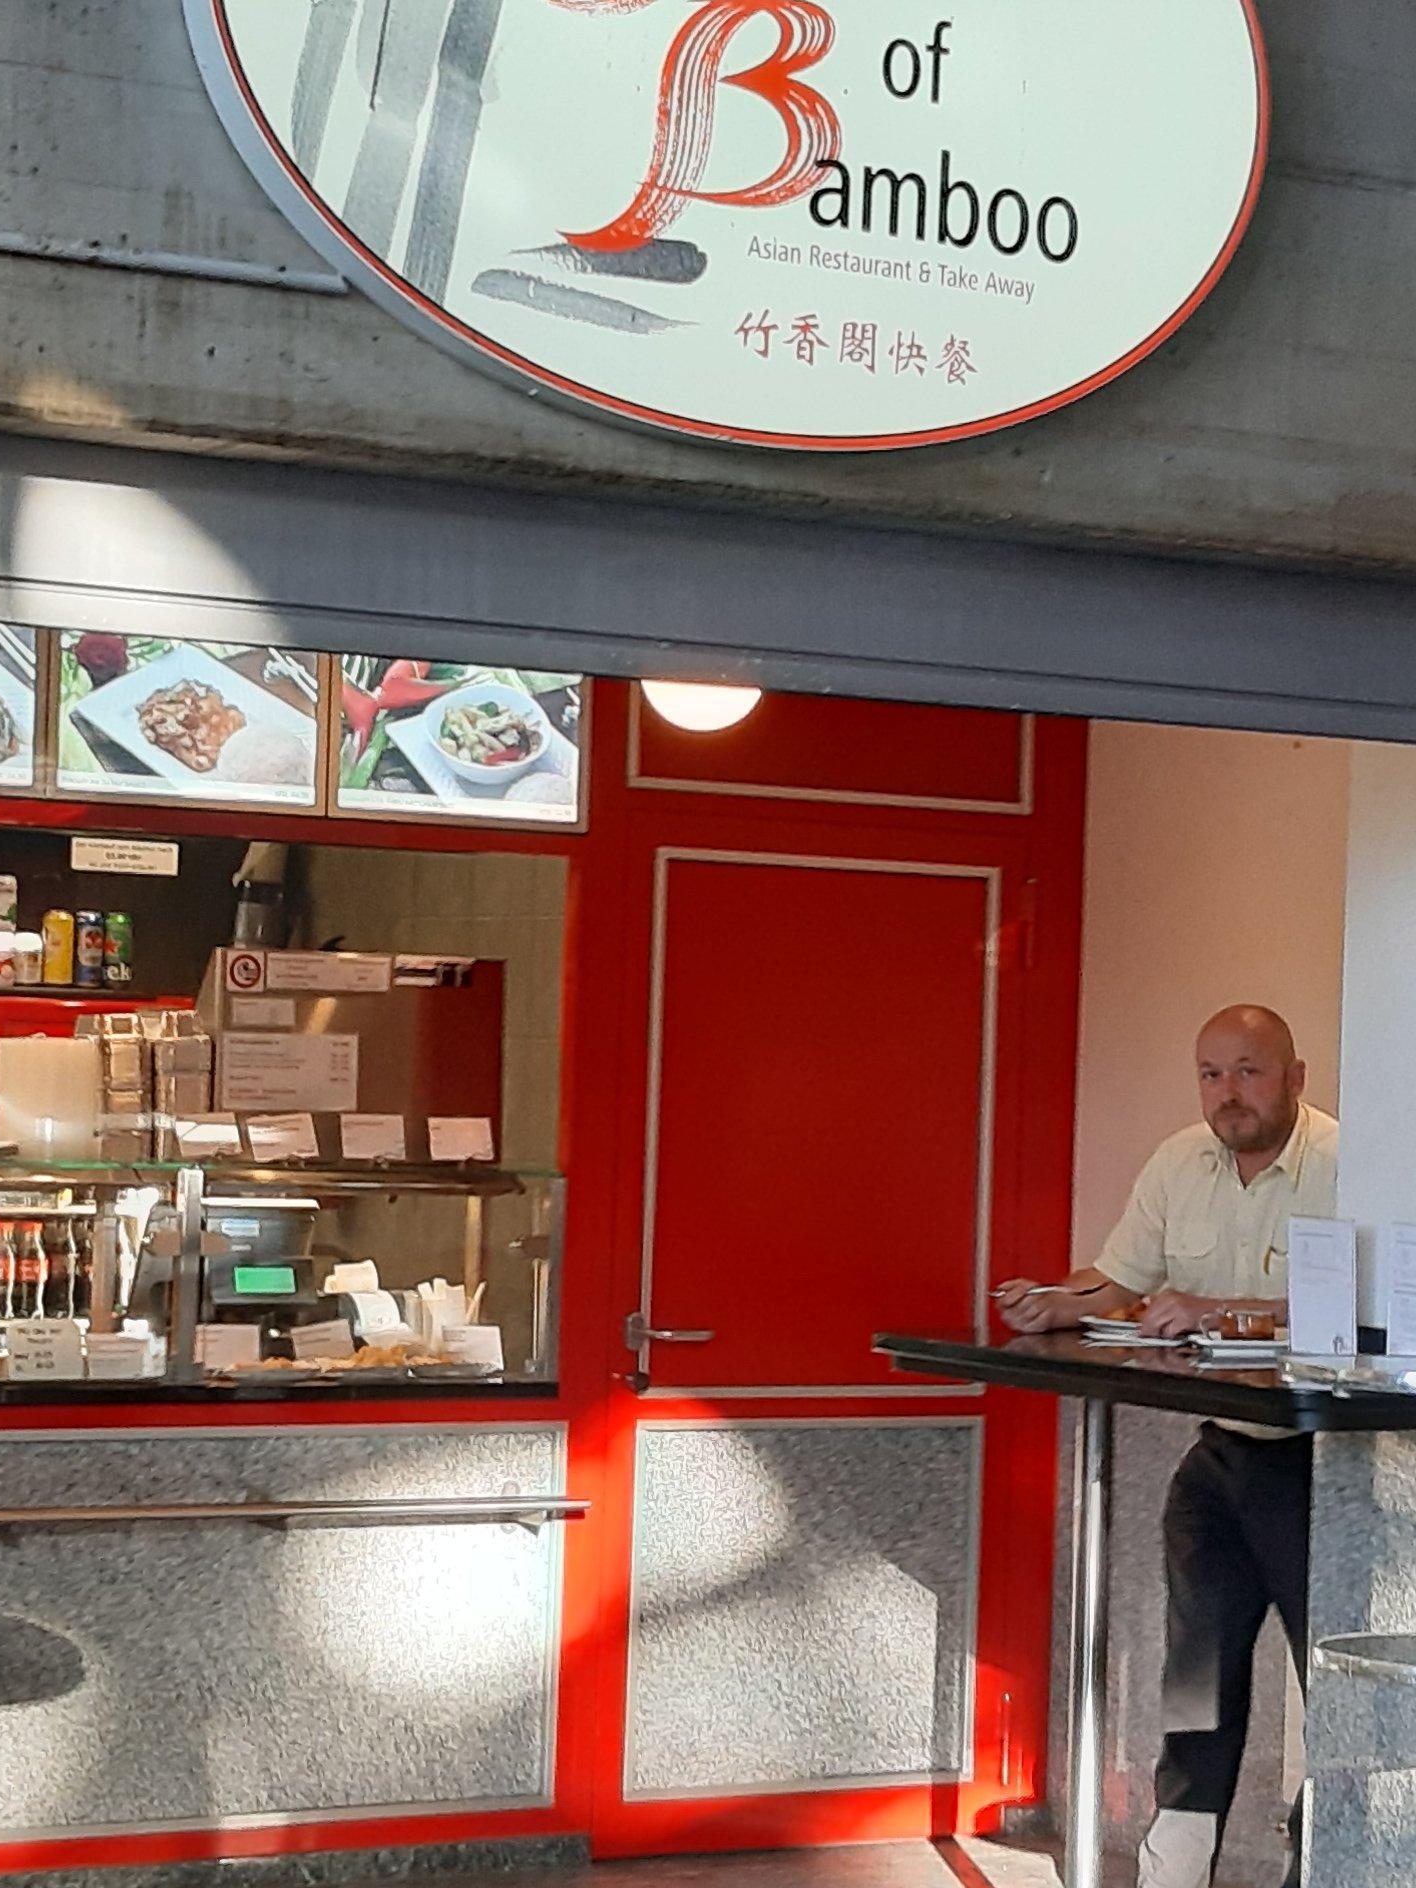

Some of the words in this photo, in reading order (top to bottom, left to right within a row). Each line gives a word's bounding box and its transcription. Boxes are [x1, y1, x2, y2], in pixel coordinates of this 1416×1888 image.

[881, 22, 951, 104] of
[747, 235, 802, 265] Asian
[809, 244, 912, 282] Restaurant
[918, 263, 932, 284] &
[937, 264, 979, 292] Take
[984, 271, 1036, 305] Away
[734, 308, 979, 386] 竹香閣快餐
